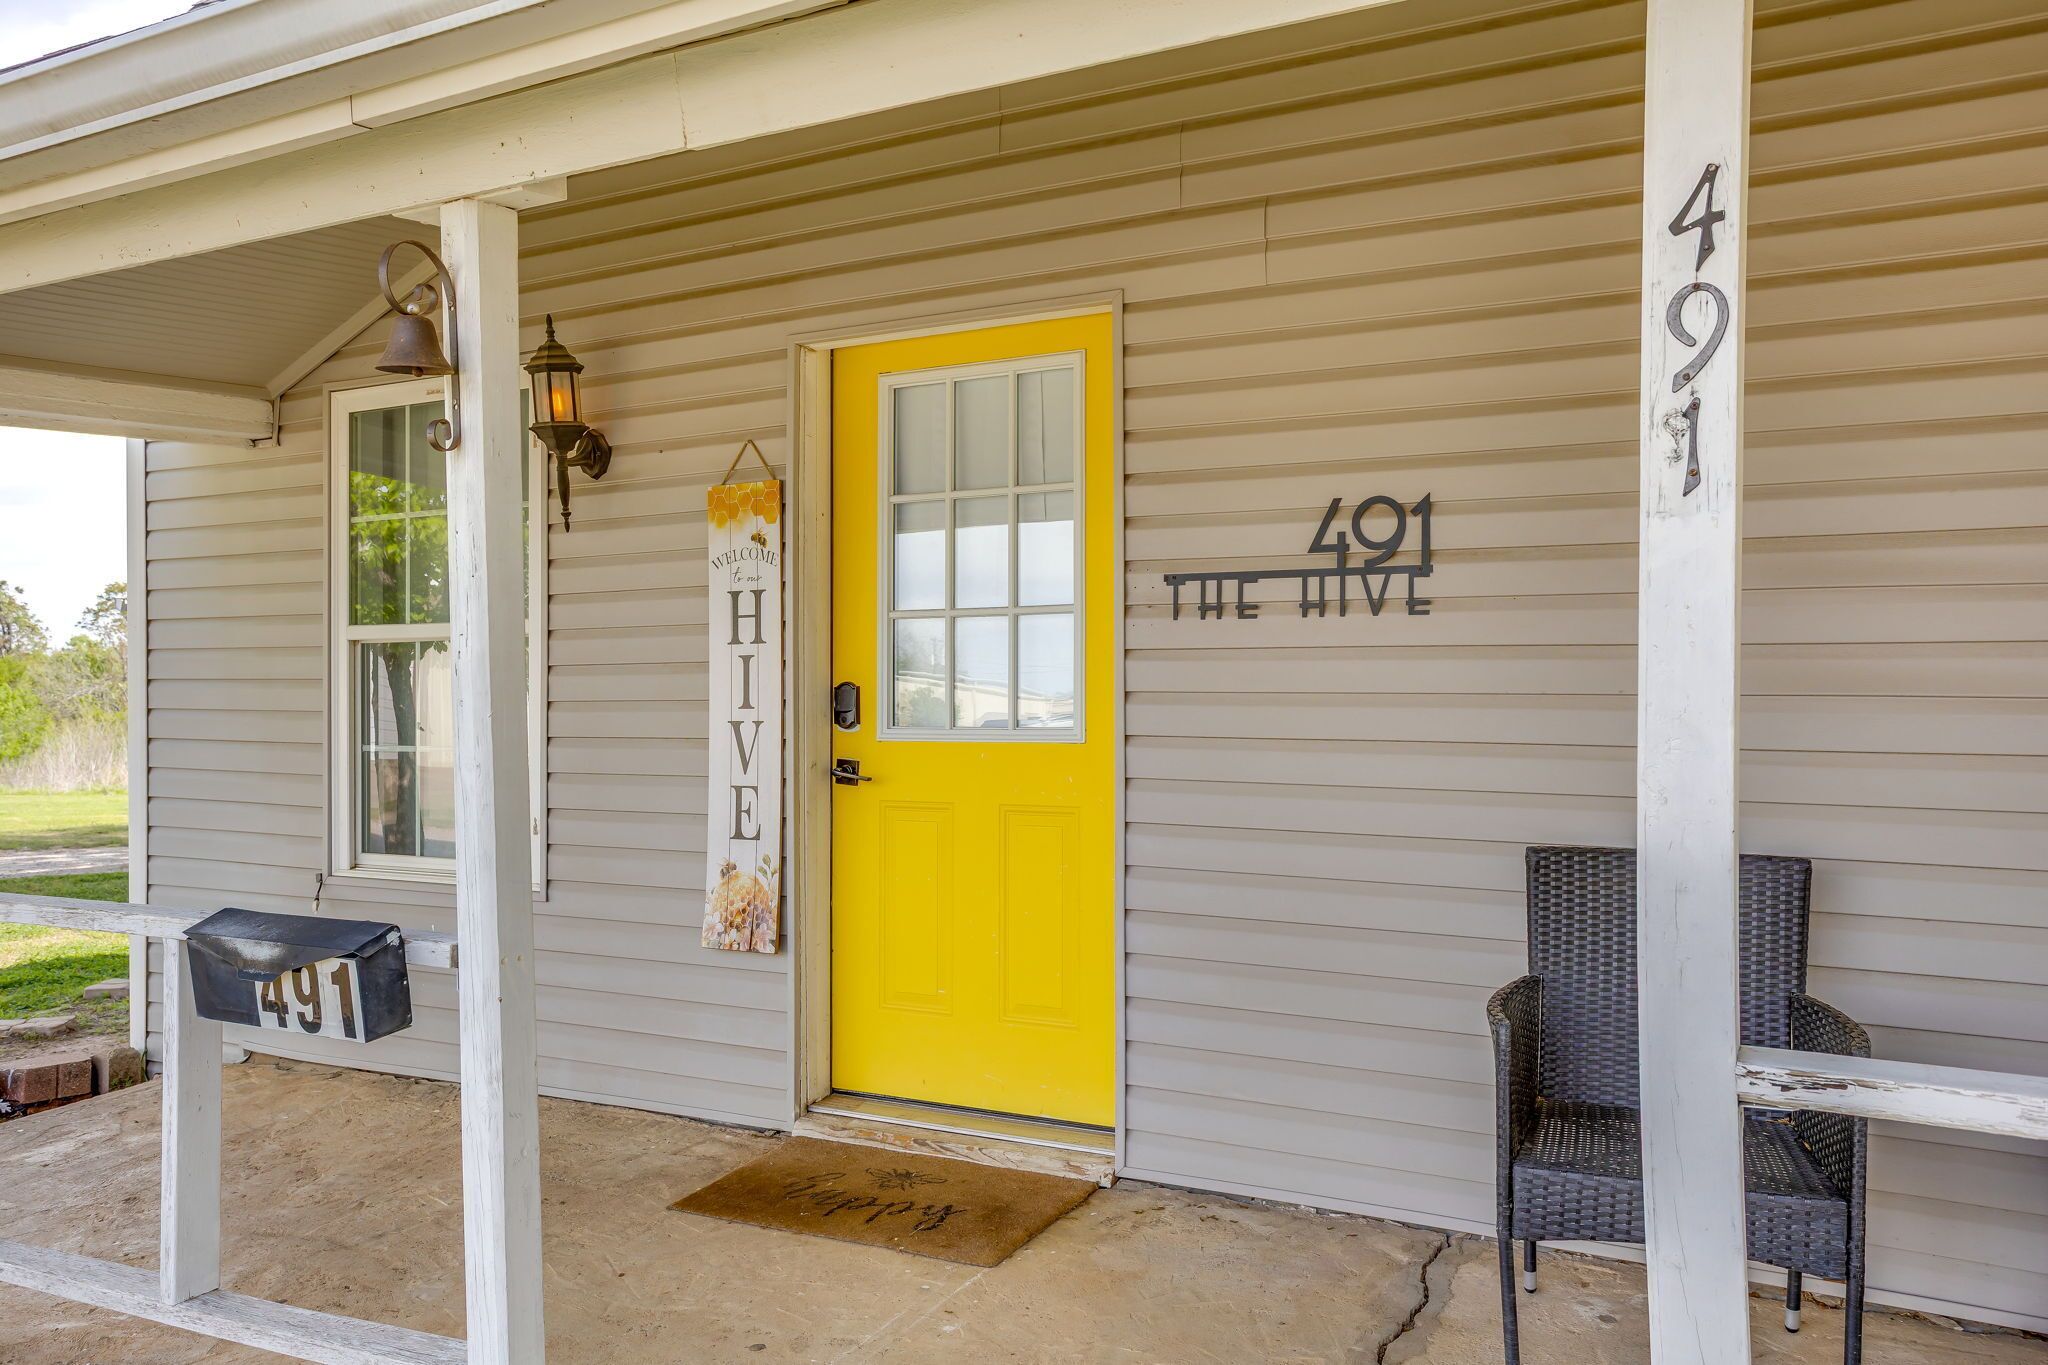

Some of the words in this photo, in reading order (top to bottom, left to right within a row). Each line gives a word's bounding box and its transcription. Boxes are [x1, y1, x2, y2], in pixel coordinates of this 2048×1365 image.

[1667, 163, 1730, 497] 491
[712, 547, 779, 570] WELCOME
[1307, 492, 1432, 570] 491
[732, 567, 744, 584] to
[747, 575, 762, 583] our
[1164, 573, 1258, 620] THE
[1299, 566, 1433, 617] HIVE
[727, 588, 767, 841] HIVE
[260, 962, 357, 1039] 491
